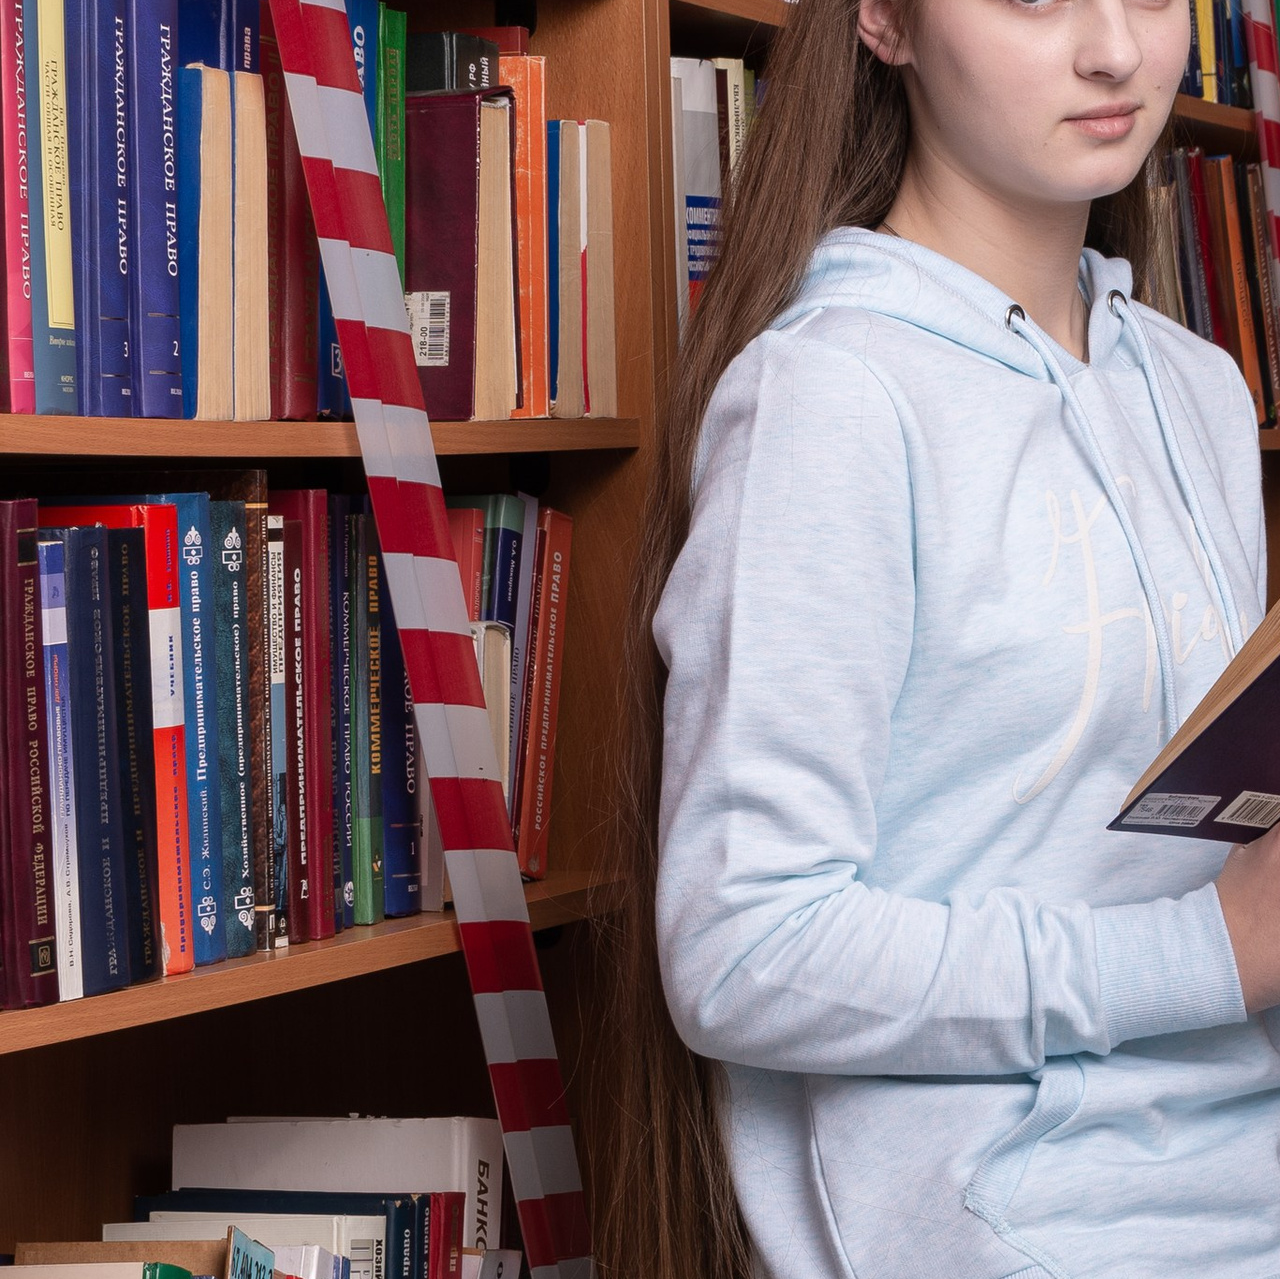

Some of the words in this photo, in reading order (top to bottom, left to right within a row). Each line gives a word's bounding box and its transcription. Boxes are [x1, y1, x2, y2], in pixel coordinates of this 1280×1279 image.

[244, 27, 252, 69] права
[469, 63, 477, 81] РФ
[14, 2, 29, 200] ГРАЖДАНСКОЕ
[51, 59, 62, 174] ГРАЖДАНСКОЕ
[115, 16, 127, 187] ГРАЖДАНСКОЕ
[160, 22, 175, 191] ГРАЖДАНСКОЕ
[47, 159, 56, 227] ОСОБЕННАЯ
[54, 181, 65, 231] ПРАВО
[19, 212, 32, 300] ПРАВО
[117, 198, 128, 275] ПРАВО
[165, 201, 178, 277] ПРАВО
[124, 342, 129, 358] 3
[173, 341, 179, 357] 2
[119, 543, 130, 597] ПРАВО
[367, 555, 380, 613] ПРАВО
[506, 559, 517, 602] Макарова
[510, 540, 518, 558] О.А.
[548, 551, 563, 603] ПРАВО
[24, 577, 36, 677] ГРАЖДАНСКОЕ
[188, 571, 203, 613] право
[231, 581, 242, 619] право
[271, 602, 278, 610] И
[276, 551, 284, 673] ПРЕДПРИЯТИЯ
[293, 568, 303, 632] ПРАВО
[167, 634, 177, 697] УЧЕБНИК
[342, 591, 351, 715] КОММЕРЧЕСКОЕ
[510, 647, 521, 685] ПРАВО
[539, 607, 557, 751] ПРЕДПРИНИМАТЕЛЬСКОЕ
[26, 685, 39, 730] ПРАВО
[120, 604, 142, 816] ПРЕДПРИНИМАТЕЛЬСКОЕ
[189, 617, 208, 782] Предпринимательское
[231, 623, 247, 777] (предпринимательское)
[369, 625, 382, 775] КОММЕРЧЕСКОЕ
[295, 637, 307, 865] ПРЕДПРИНИМАТЕЛЬСКОЕ
[343, 722, 352, 774] ПРАВО
[404, 723, 417, 794] ПРАВО
[28, 739, 44, 833] РОССИЙСКОЙ
[343, 780, 353, 847] РОССИИ
[534, 755, 547, 831] РОССИЙСКОЕ
[100, 838, 112, 851] И
[198, 786, 210, 860] Жилинский.
[237, 781, 250, 880] Хозяйственное
[32, 842, 48, 925] ФЕДЕРАЦИИ
[136, 849, 153, 965] ГРАЖДАНСКОЕ
[201, 865, 210, 891] С.Э.
[101, 857, 118, 975] ГРАЖДАНСКОЕ
[401, 1229, 412, 1276] право
[447, 1203, 459, 1272] право
